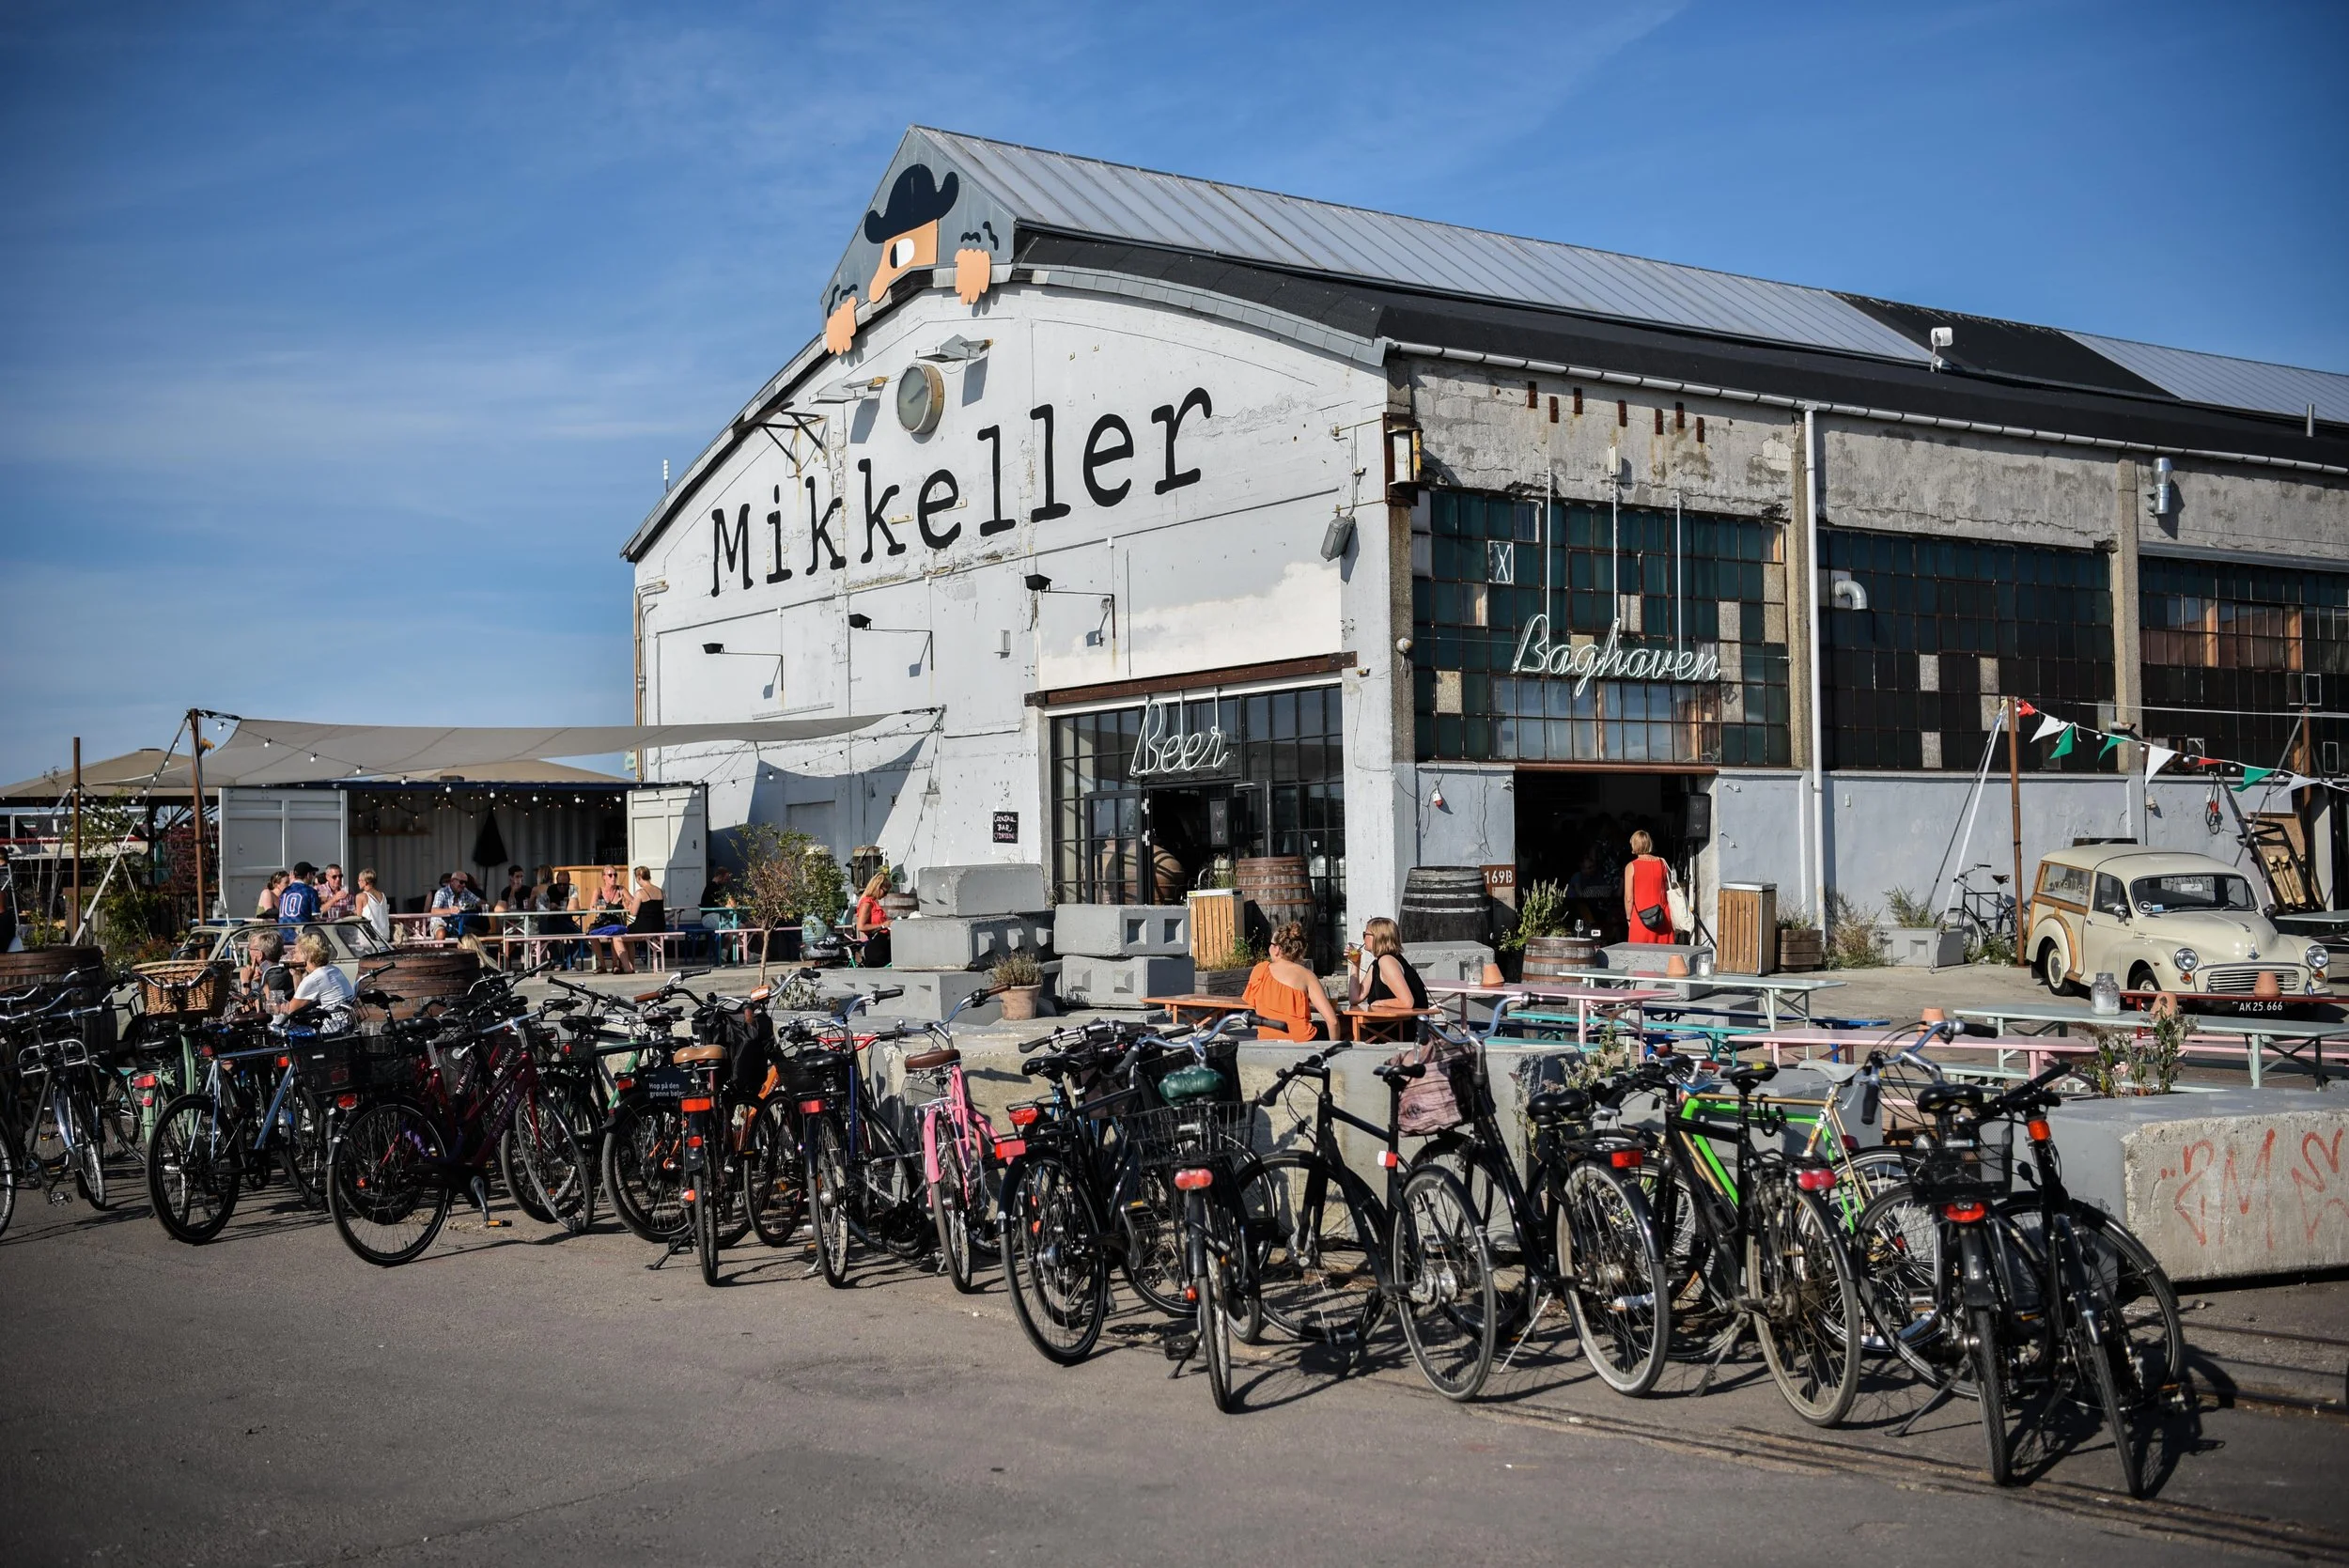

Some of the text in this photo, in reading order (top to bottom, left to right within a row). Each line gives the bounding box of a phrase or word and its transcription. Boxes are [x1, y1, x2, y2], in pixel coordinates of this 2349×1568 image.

[710, 387, 1212, 598] Mikkeller
[1513, 613, 1721, 699] Baghaven
[1129, 700, 1231, 776] Beer
[997, 824, 1013, 832] BAR
[1484, 870, 1513, 884] 169B
[278, 893, 303, 918] 10
[648, 1082, 660, 1091] Hop
[661, 1081, 668, 1091] på
